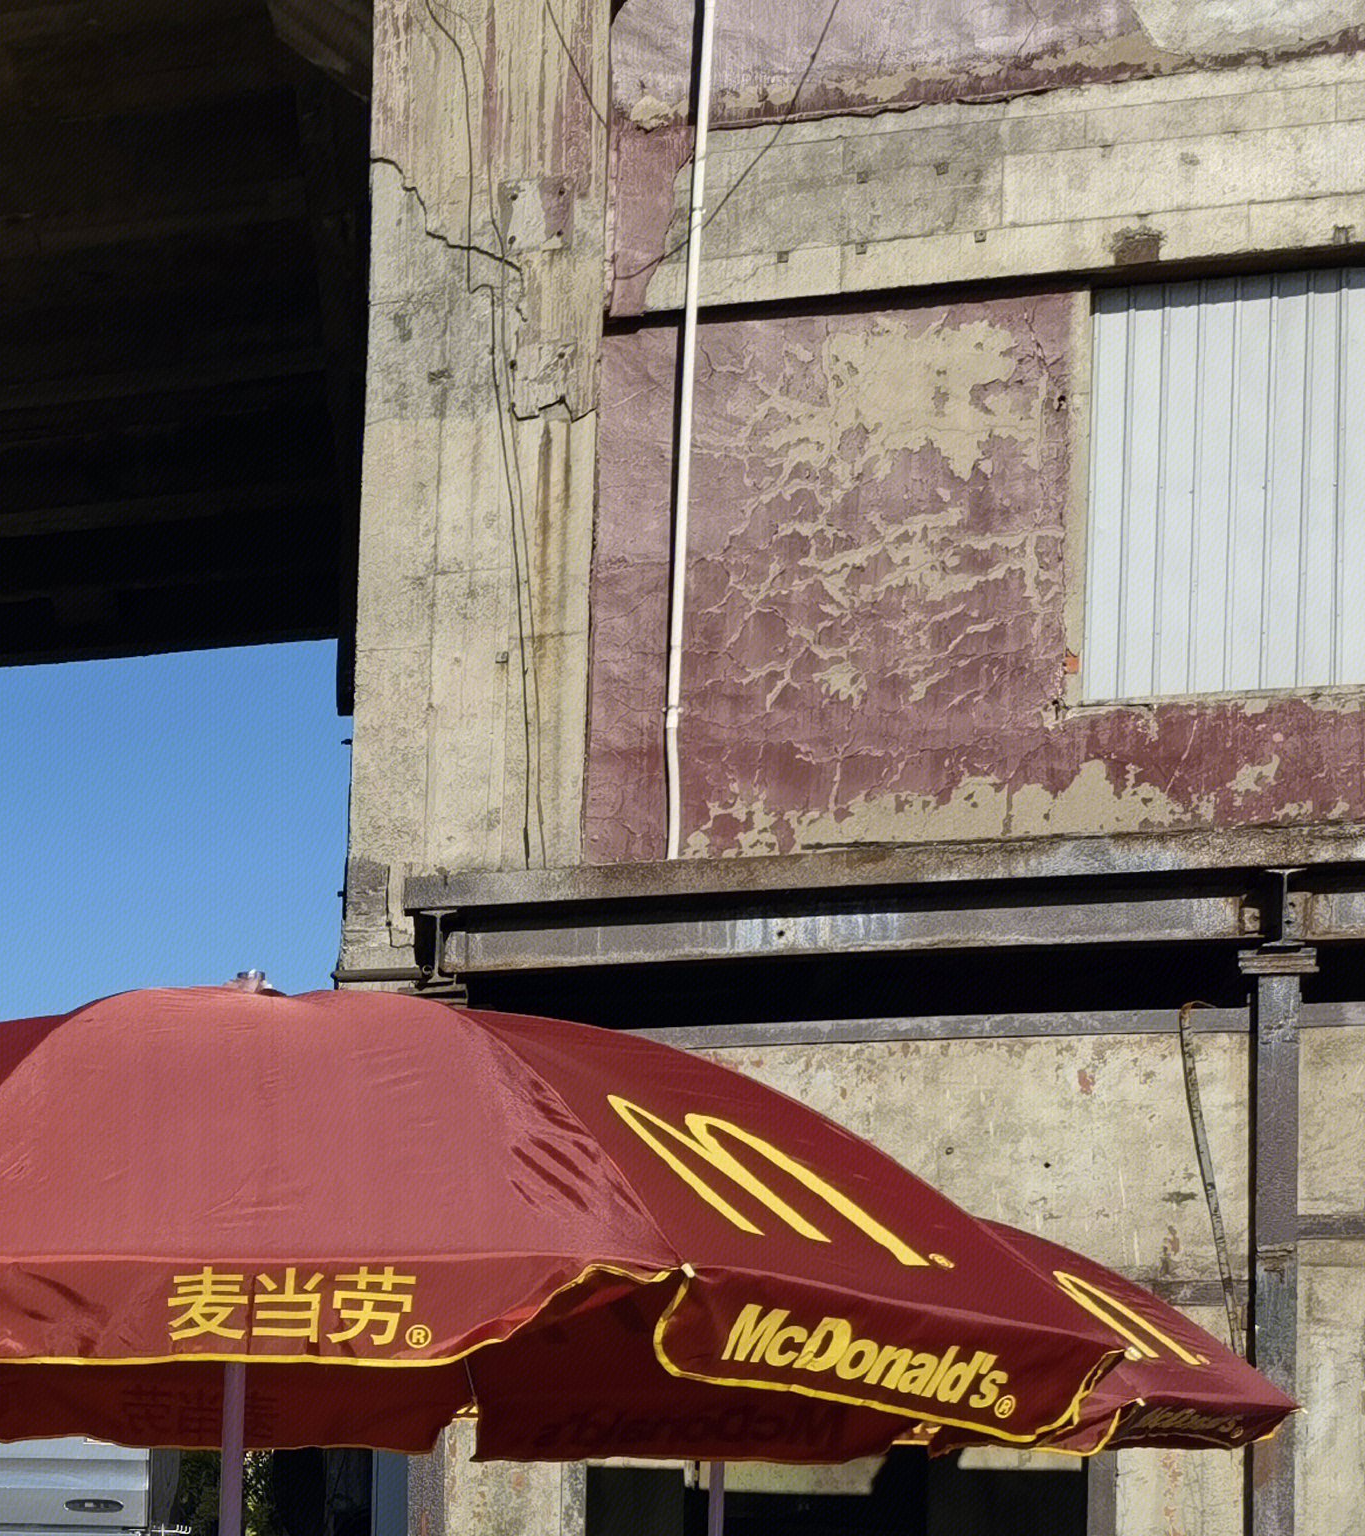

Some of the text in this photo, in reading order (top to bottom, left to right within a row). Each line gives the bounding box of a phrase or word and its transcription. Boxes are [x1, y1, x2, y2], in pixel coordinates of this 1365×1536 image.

[168, 1266, 417, 1346] 麦当劳
[721, 1303, 1009, 1409] McDonald's
